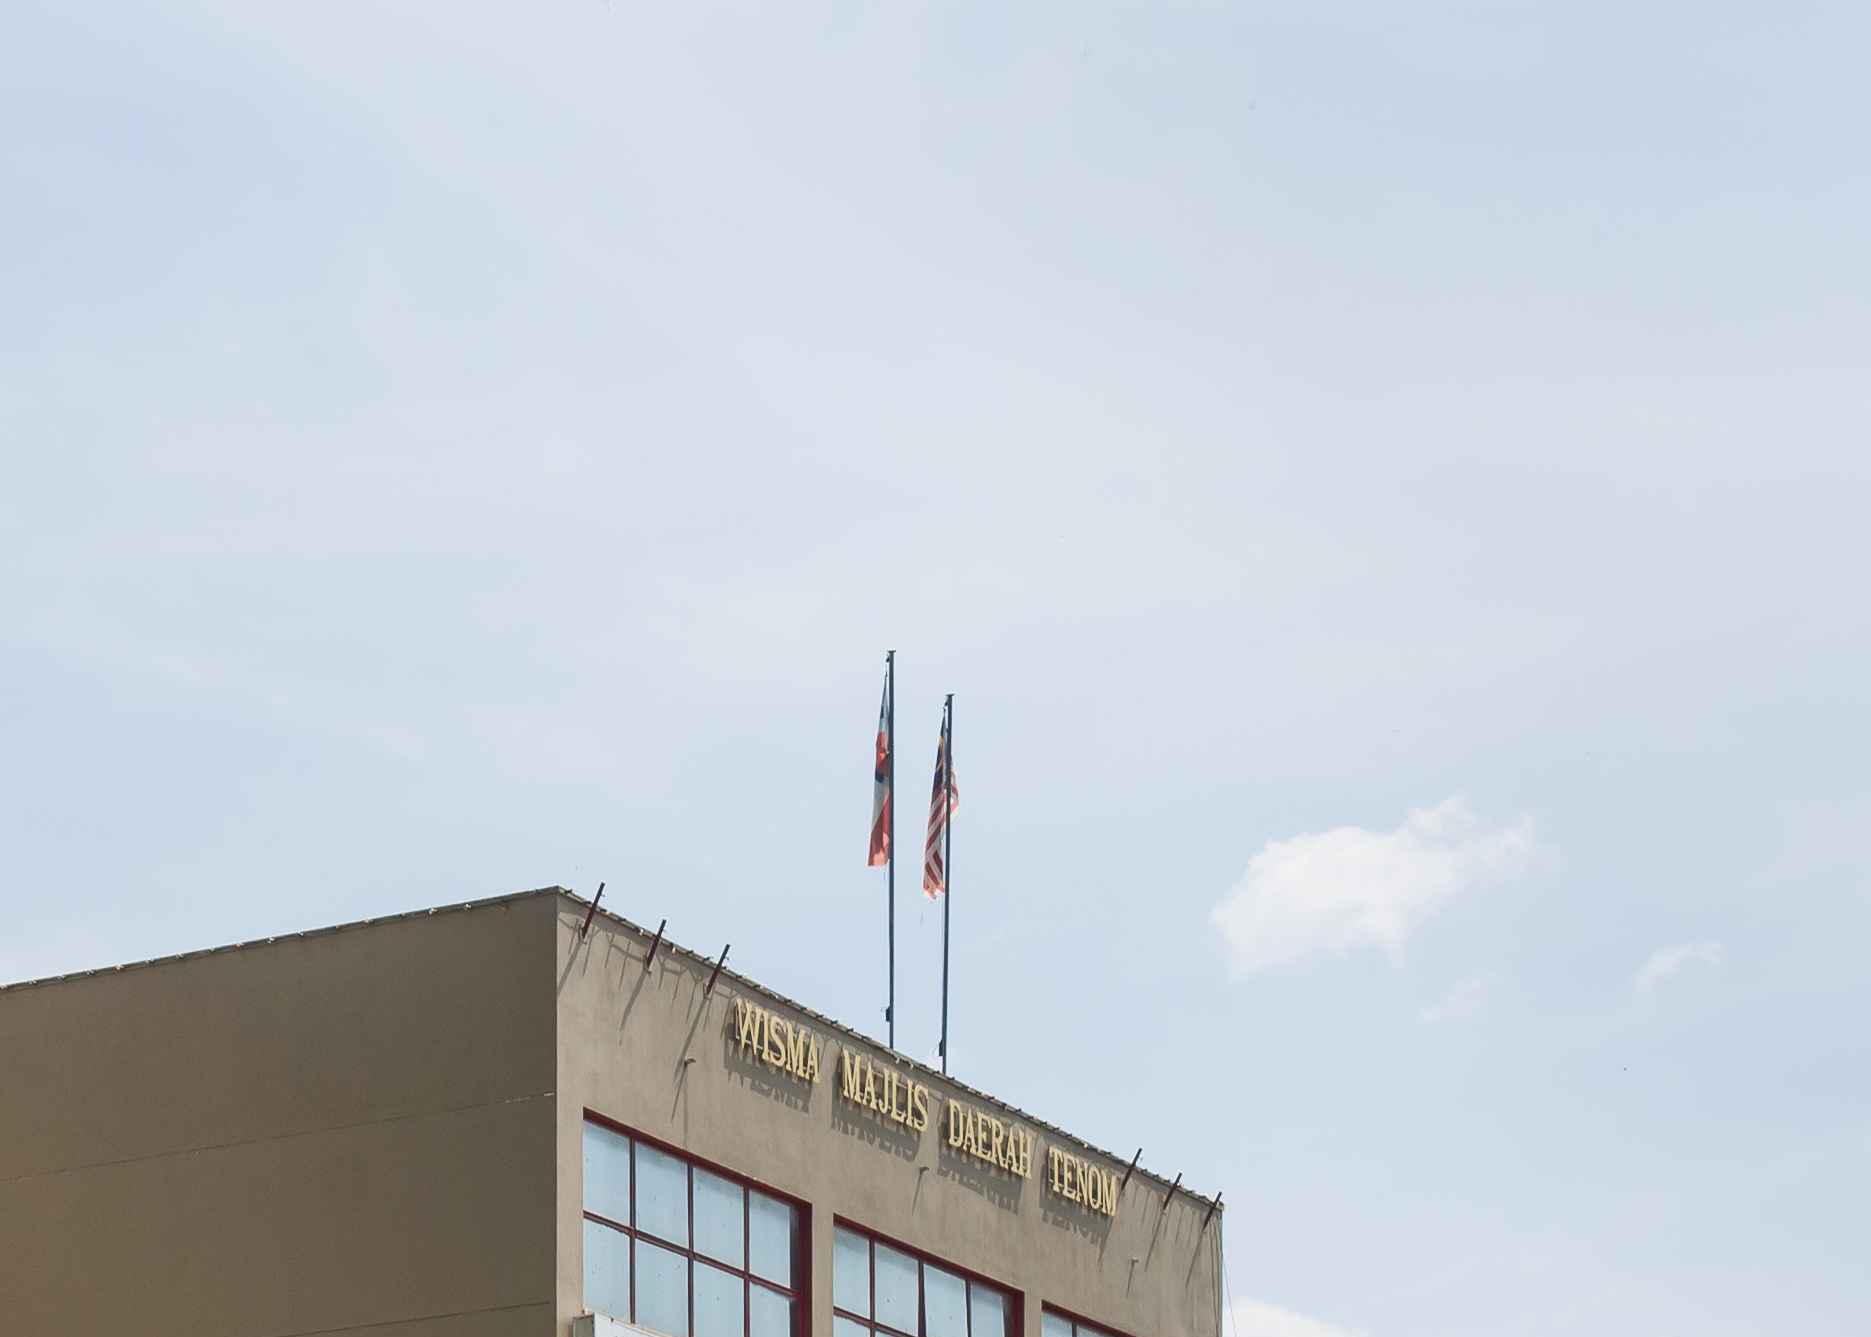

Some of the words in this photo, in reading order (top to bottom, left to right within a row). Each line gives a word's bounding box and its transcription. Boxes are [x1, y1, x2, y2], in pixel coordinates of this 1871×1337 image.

[735, 998, 821, 1084] WISMA
[841, 1048, 929, 1132] MAJLIS
[948, 1099, 1033, 1179] DAERAH
[1048, 1145, 1121, 1216] TENOM
